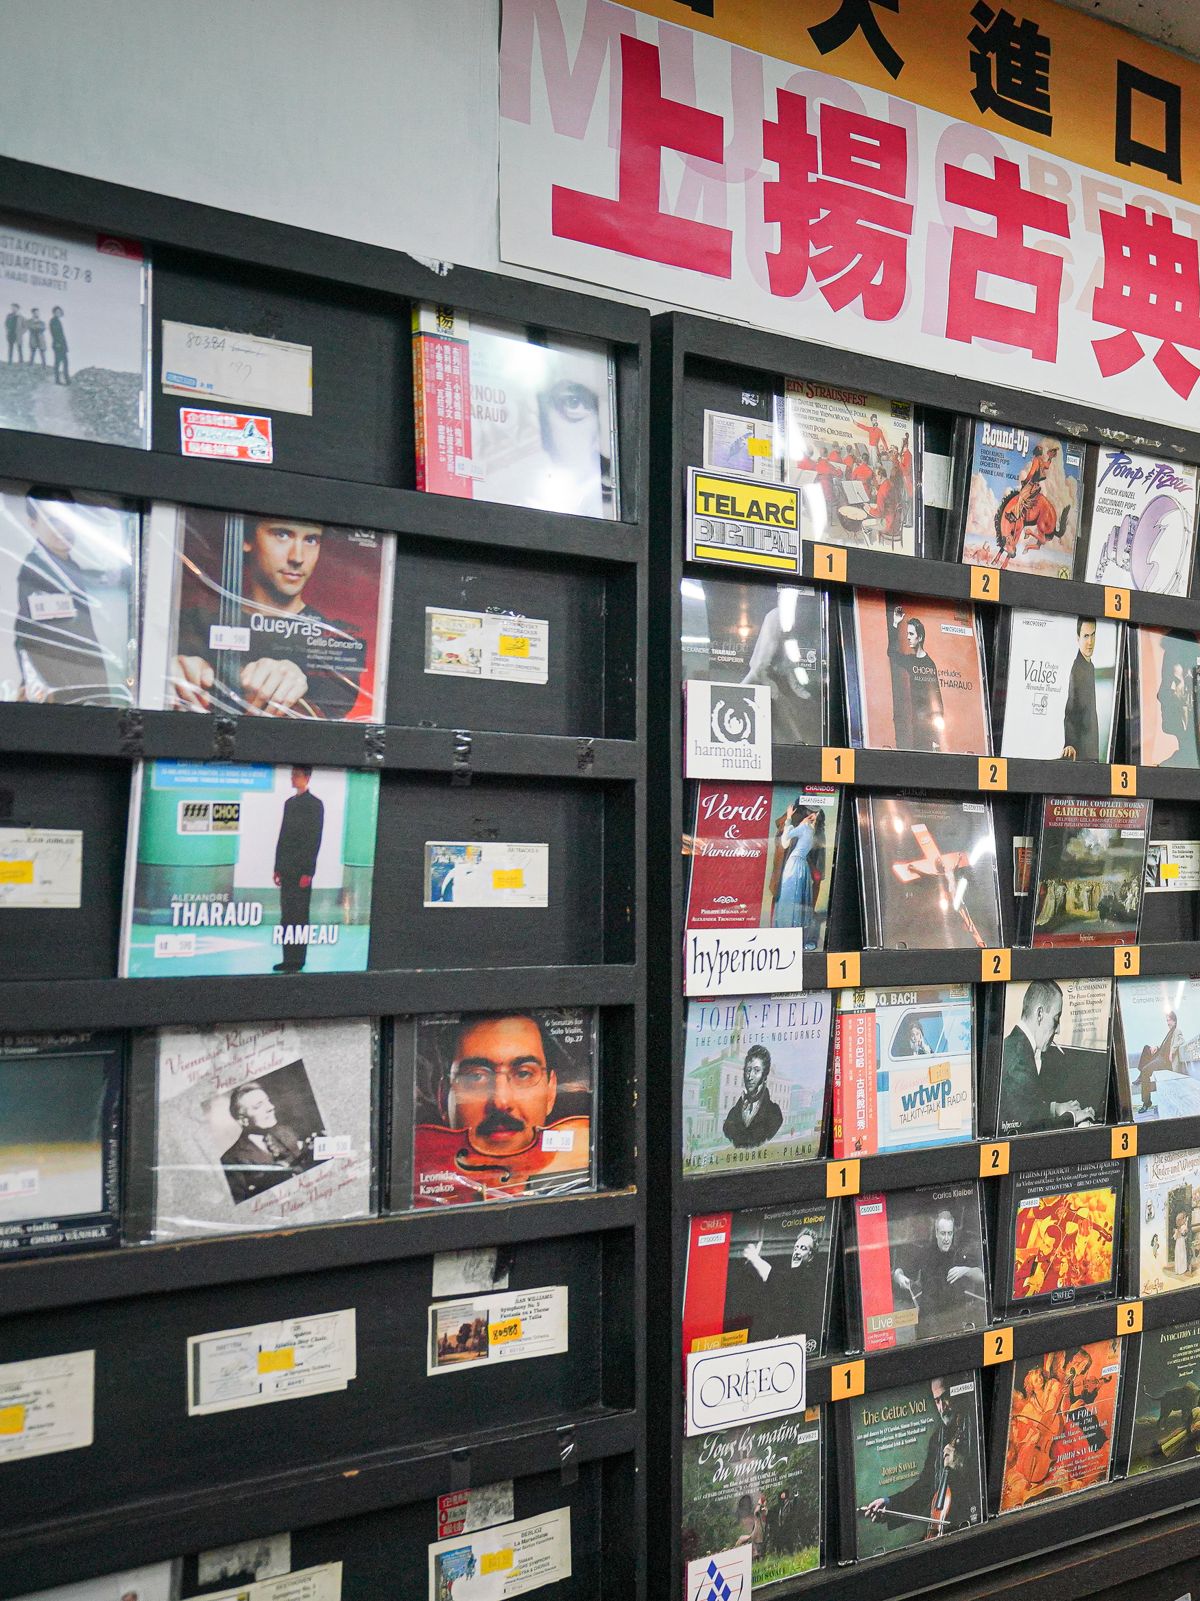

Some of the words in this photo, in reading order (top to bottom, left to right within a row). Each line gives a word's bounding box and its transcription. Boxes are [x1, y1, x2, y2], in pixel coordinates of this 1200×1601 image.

[806, 382, 868, 406] STRAUSSFEST
[982, 422, 1029, 457] Round-Up
[1098, 451, 1144, 488] Pomp
[698, 490, 795, 525] TELARC
[1095, 505, 1124, 516] ORCHESTRA
[695, 518, 798, 555] DIGITAL
[250, 612, 322, 638] Queyras
[912, 666, 936, 675] CHOPIN
[1024, 659, 1058, 684] Valses
[939, 679, 973, 690] THARAUD
[694, 740, 753, 758] harmonia
[721, 755, 761, 770] mundi
[213, 804, 240, 819] CHOC
[701, 794, 768, 821] Verdi
[1053, 807, 1097, 817] GARRICK
[1100, 808, 1141, 819] OHLSSON
[1090, 800, 1123, 808] COMPLETE
[1124, 801, 1145, 809] WORKS
[724, 824, 740, 839] &
[700, 843, 762, 858] Variations
[170, 901, 263, 927] THARAUD
[272, 924, 339, 946] RAMEAU
[692, 935, 796, 988] hyperion
[892, 992, 917, 1004] BACH
[696, 1004, 752, 1032] JOHN
[760, 1001, 823, 1029] FIELD
[717, 1032, 765, 1045] COMPLETE
[771, 1029, 821, 1042] NOCTURNES
[902, 1079, 952, 1112] wtwp
[947, 1091, 967, 1105] RADIO
[420, 1184, 454, 1195] Kavakos
[932, 1191, 952, 1200] Carlos
[953, 1188, 973, 1197] Kleiber
[782, 1218, 802, 1228] Carlos
[803, 1215, 826, 1225] Kleiber
[872, 1317, 893, 1330] Live
[700, 1361, 795, 1404] ORFEO
[881, 1403, 907, 1422] Celtic
[908, 1399, 926, 1414] Viol
[698, 1430, 737, 1465] Tous
[738, 1426, 755, 1457] les
[756, 1420, 800, 1447] matins
[713, 1458, 732, 1483] du
[733, 1446, 788, 1477] monde
